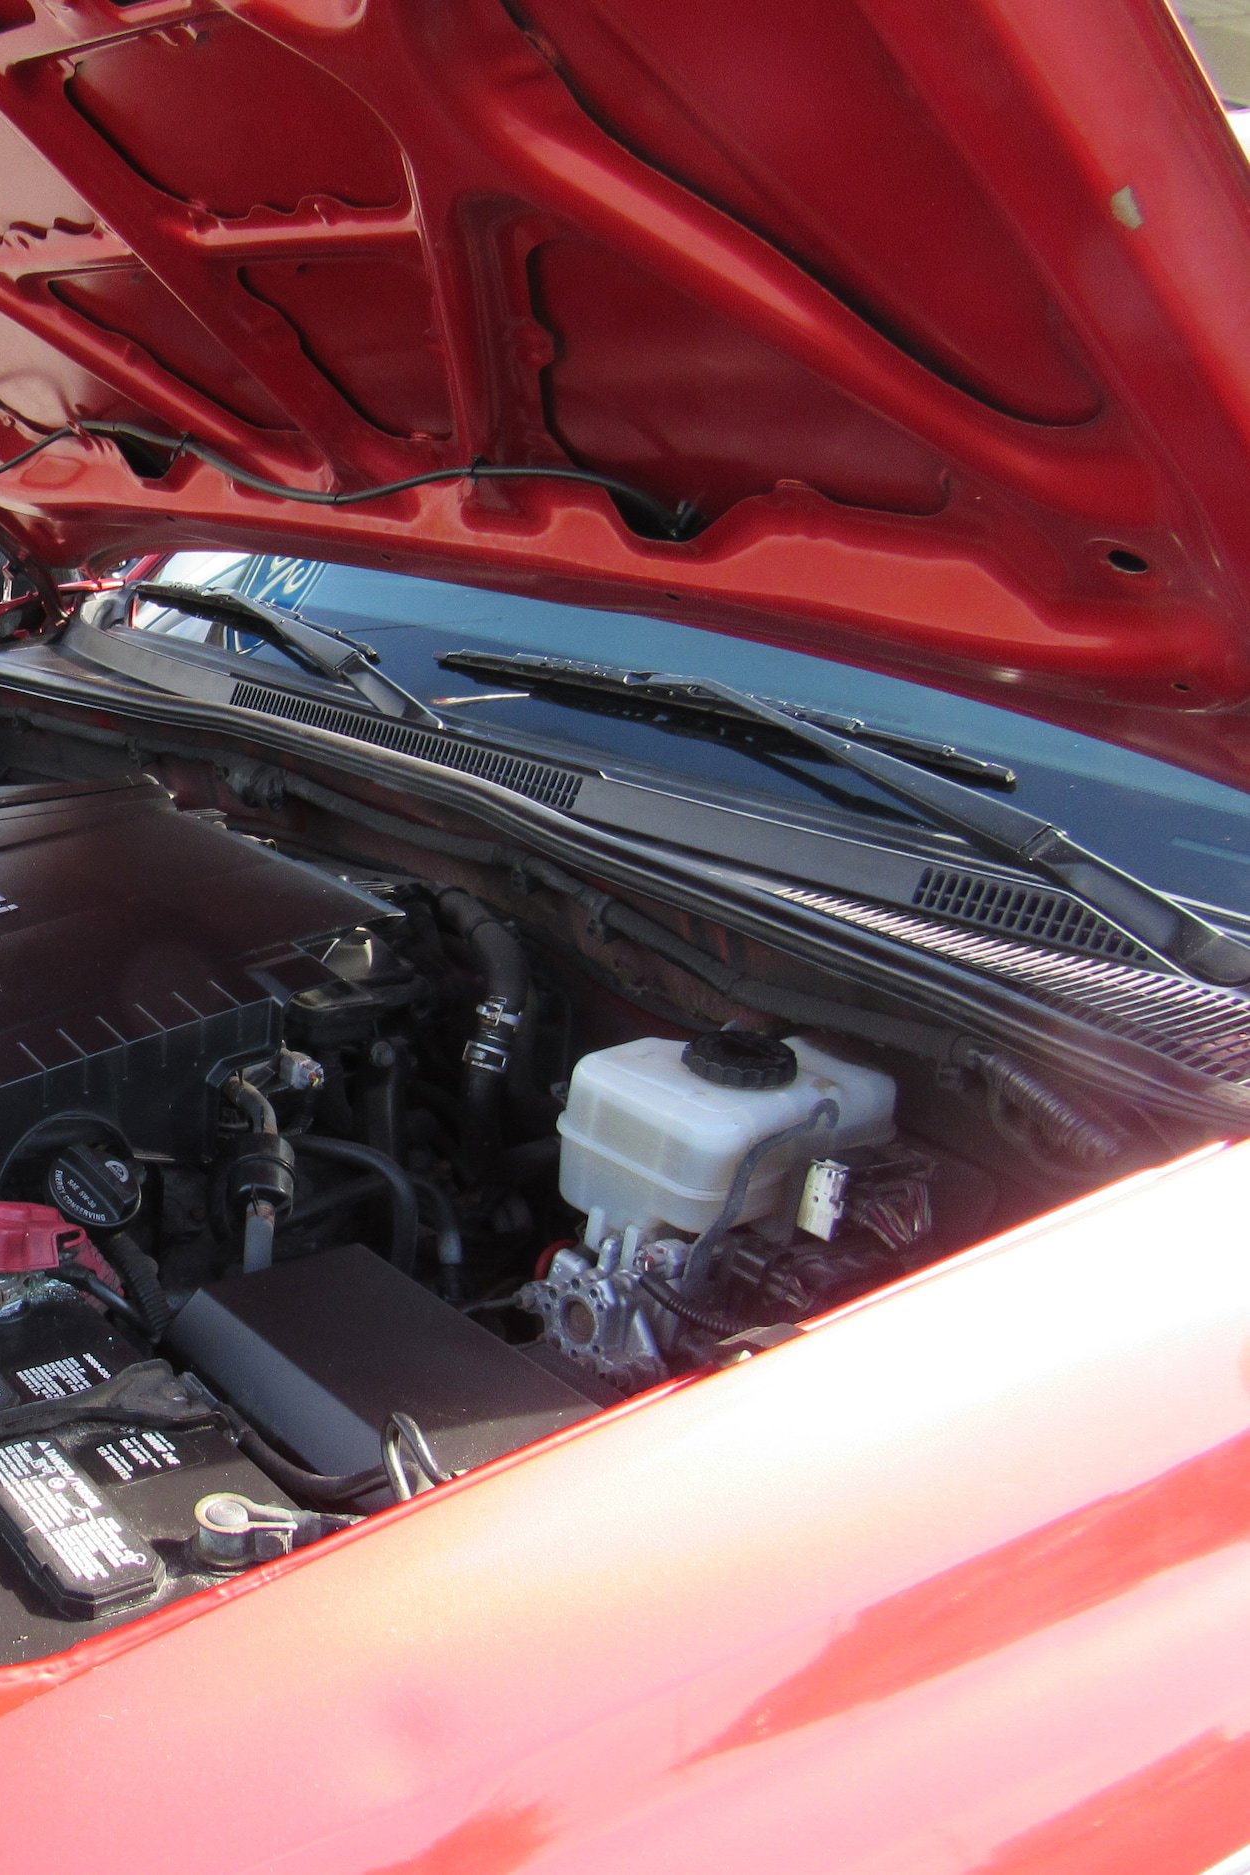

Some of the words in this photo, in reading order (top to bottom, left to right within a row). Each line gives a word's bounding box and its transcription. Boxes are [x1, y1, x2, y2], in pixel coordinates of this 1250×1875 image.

[55, 1169, 66, 1194] ENERGY
[63, 1195, 106, 1222] CONSERVING
[129, 1448, 149, 1464] AMPS
[142, 1432, 168, 1452] GROUP
[161, 1452, 181, 1464] 24F
[105, 1455, 132, 1480] MINUTES
